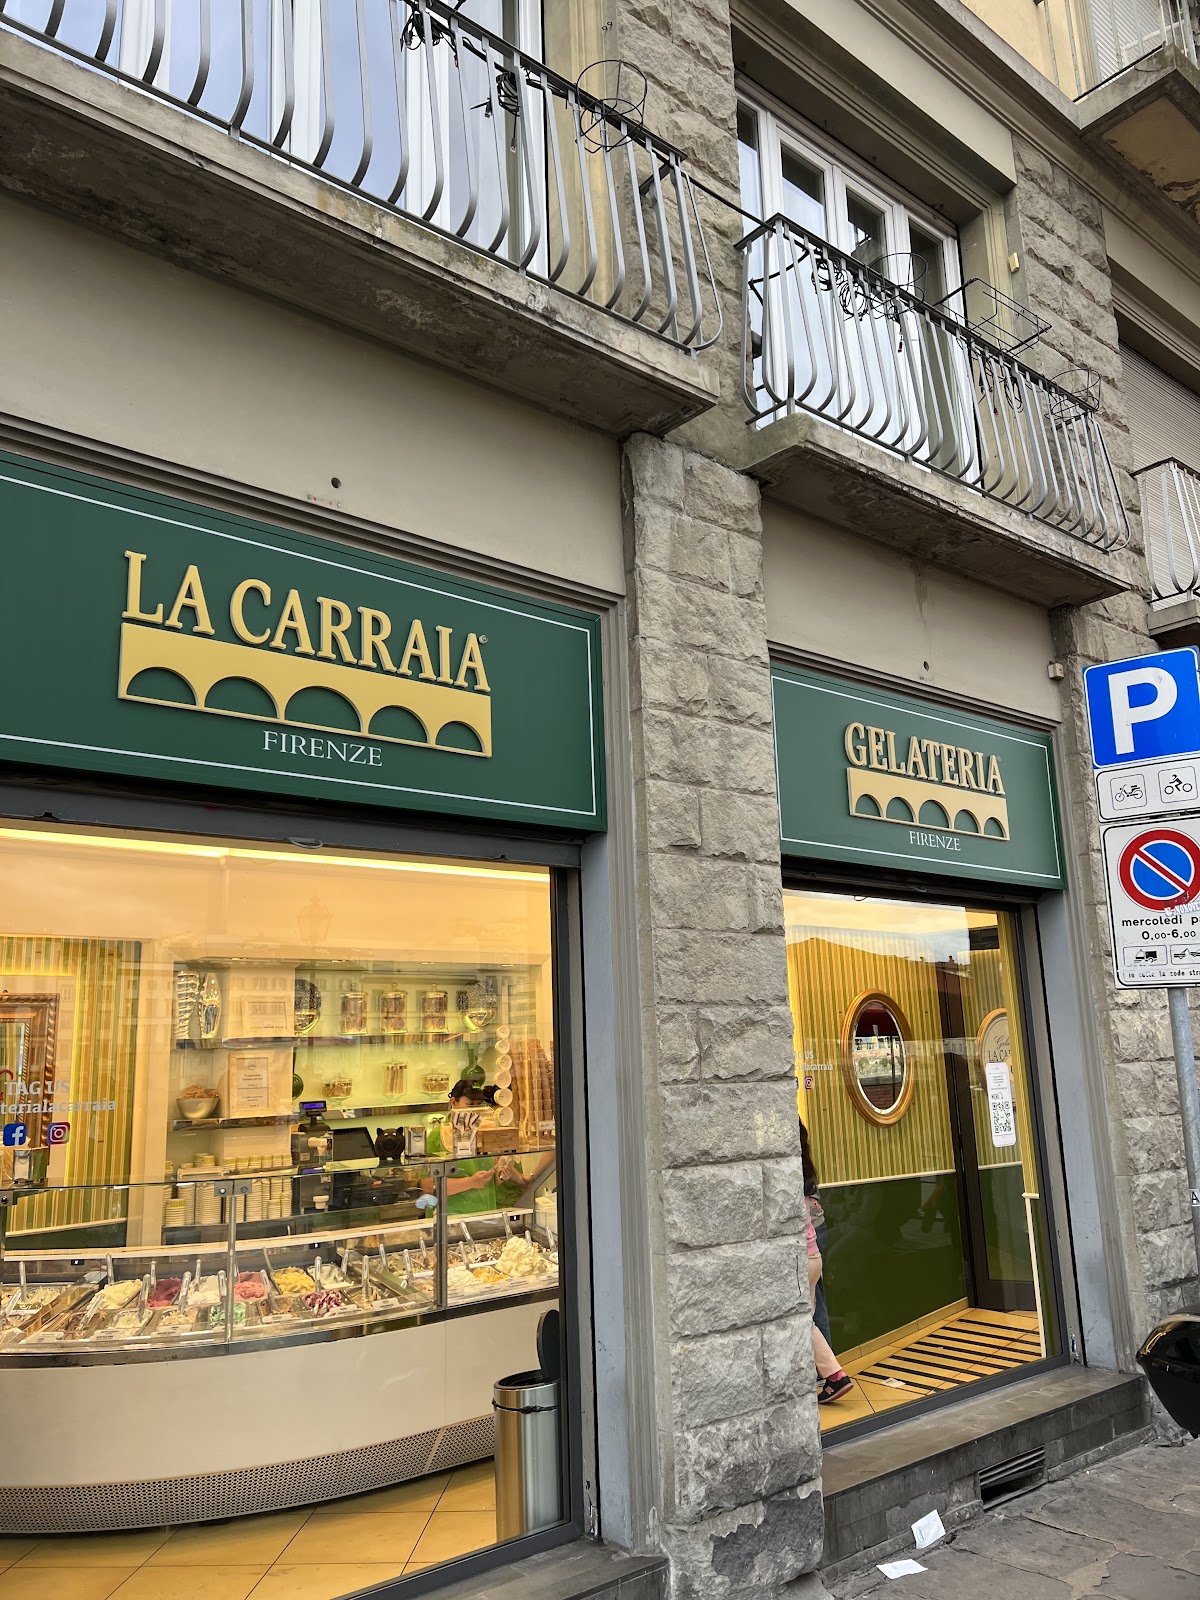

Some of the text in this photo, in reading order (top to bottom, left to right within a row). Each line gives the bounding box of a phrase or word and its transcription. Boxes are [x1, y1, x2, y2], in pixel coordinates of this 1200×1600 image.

[121, 550, 491, 693] LA CARRAIA
[1108, 666, 1178, 755] P
[263, 730, 383, 767] FIRENZE
[844, 722, 1006, 795] GELATERIA
[909, 830, 961, 851] FIRENZE
[4, 1080, 70, 1096] TAG US
